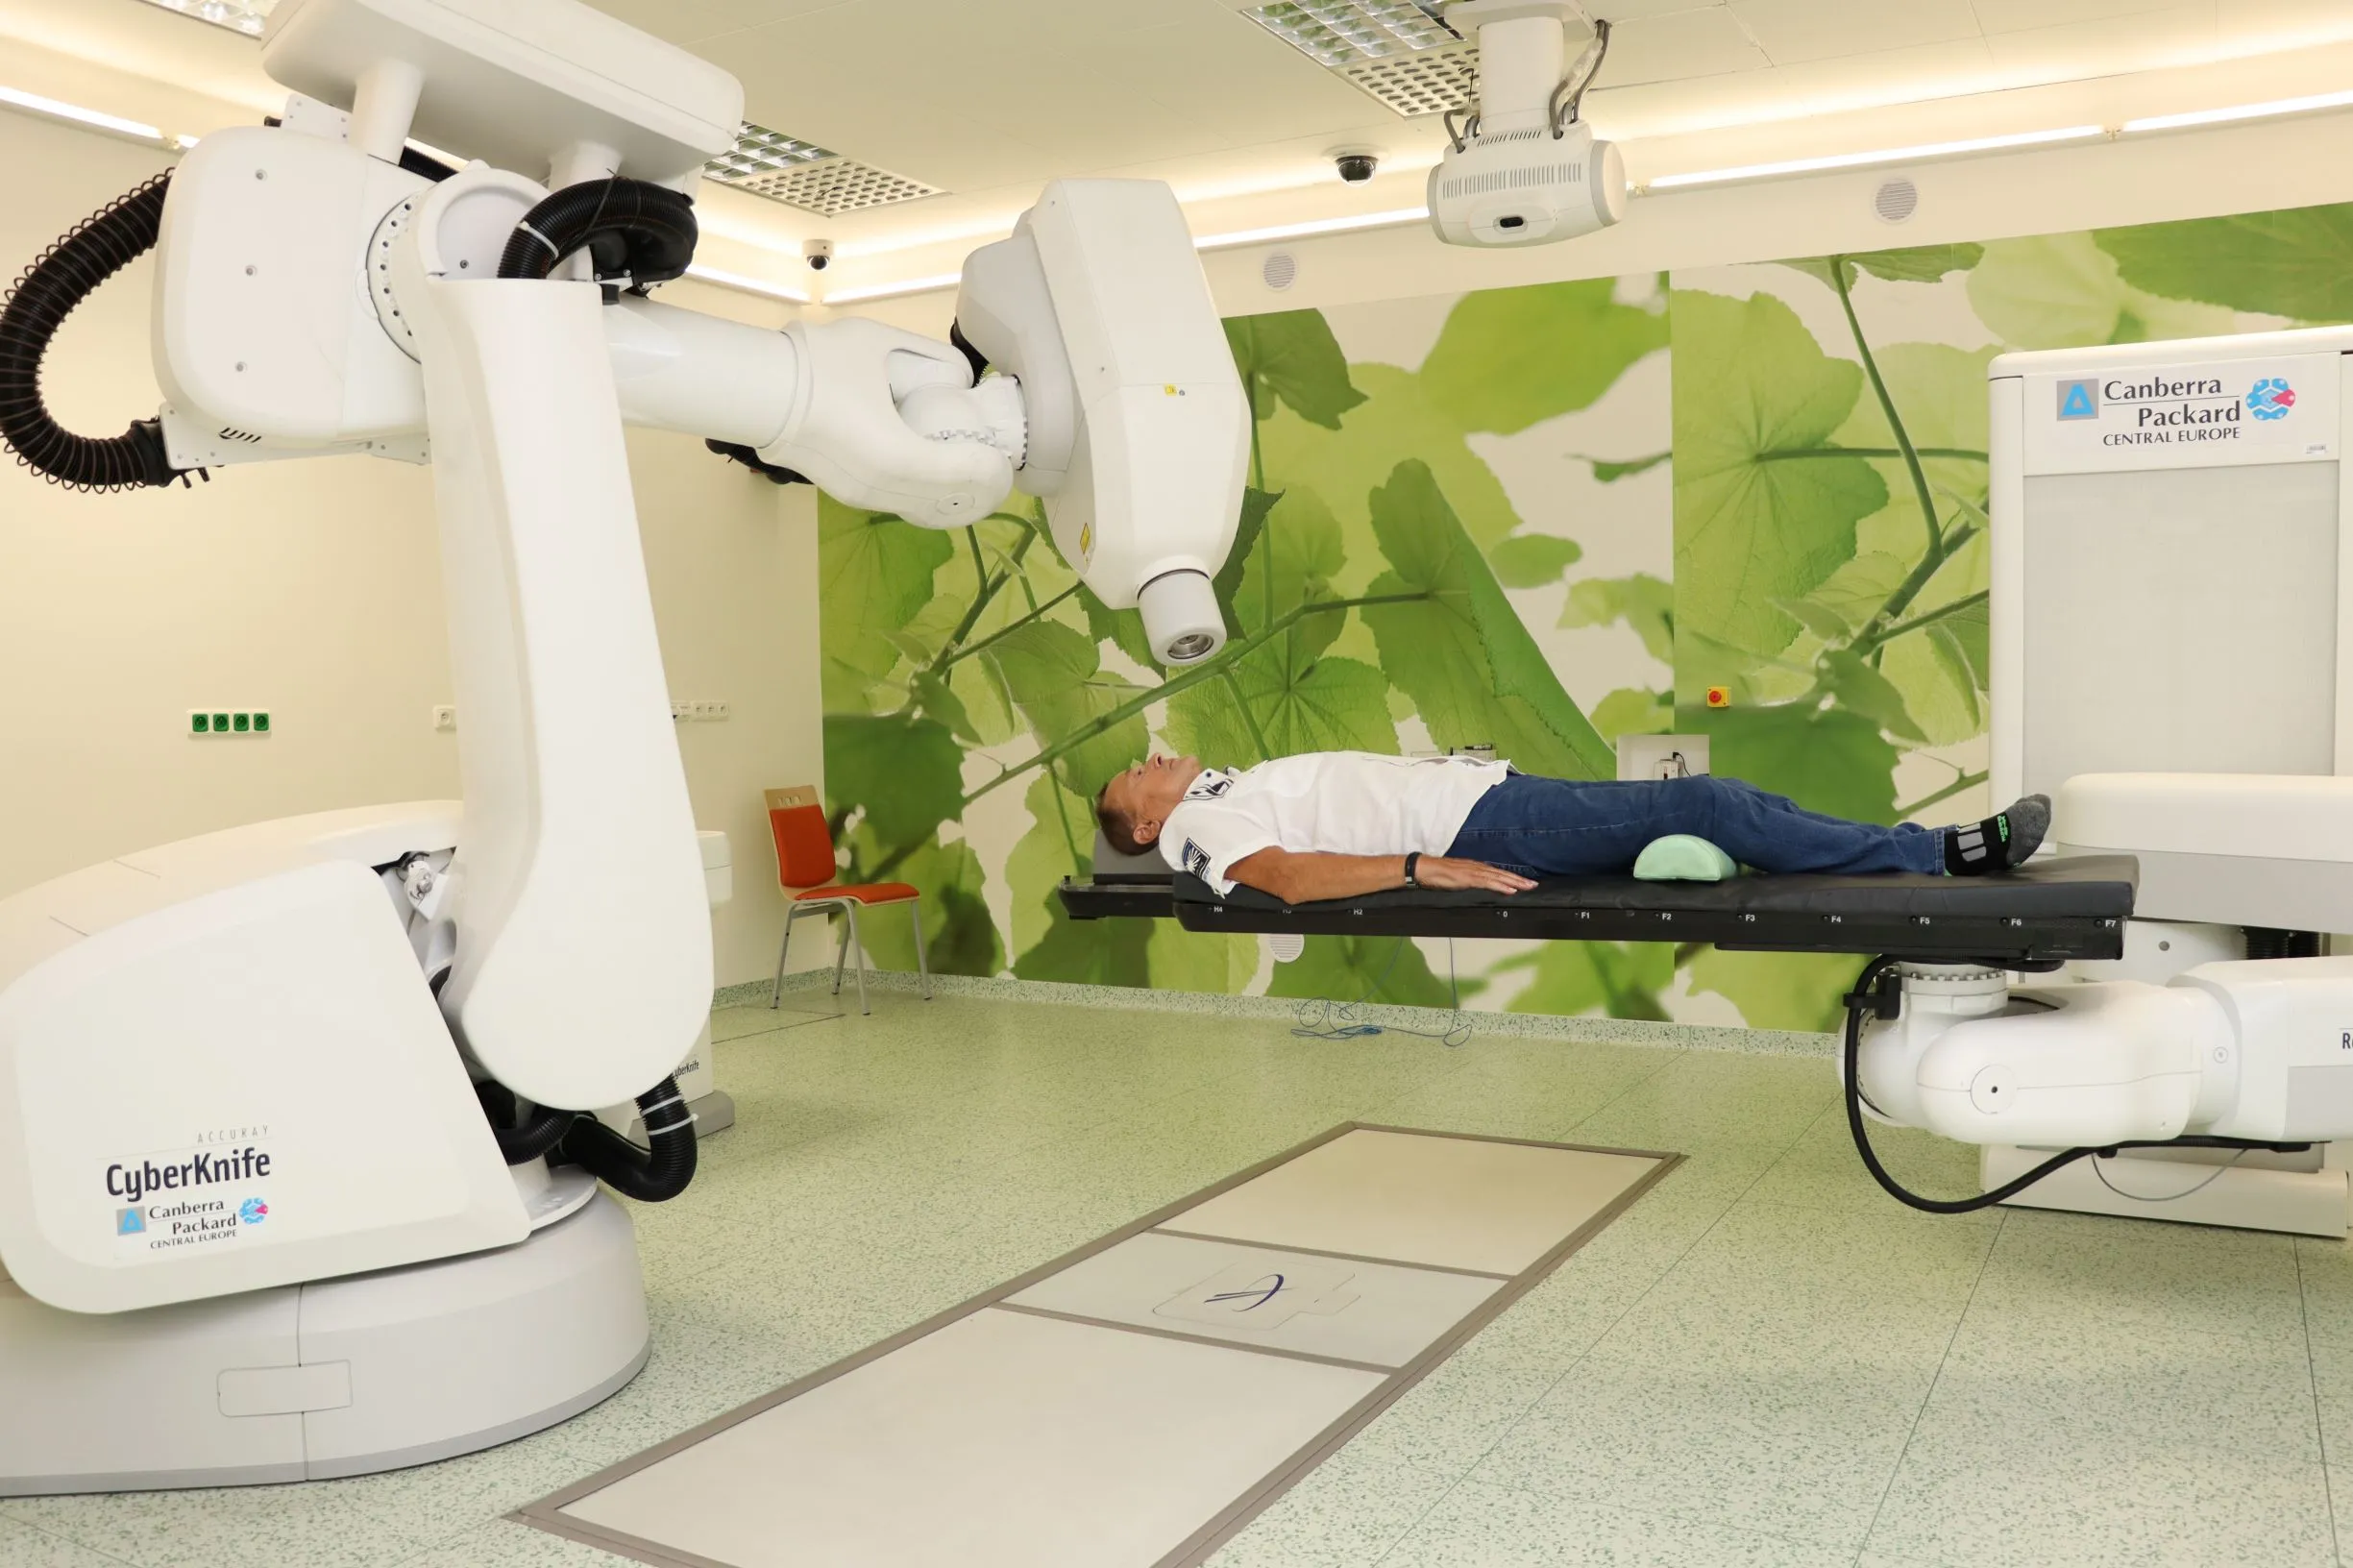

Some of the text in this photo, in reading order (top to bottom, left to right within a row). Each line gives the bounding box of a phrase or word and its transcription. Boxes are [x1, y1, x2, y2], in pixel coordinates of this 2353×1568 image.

[2104, 377, 2222, 401] Canberra
[2139, 400, 2241, 428] Packard
[2102, 427, 2241, 447] CENTRAL EUROPE
[2105, 919, 2117, 928] F7
[2342, 1032, 2353, 1049] R
[674, 1060, 699, 1080] yberKnife
[197, 1124, 269, 1144] ACCURAY
[106, 1146, 271, 1203] CyberKnife
[149, 1200, 224, 1219] Canberra
[172, 1213, 236, 1235] Packard
[150, 1229, 237, 1249] CENTRAL EUROPE
